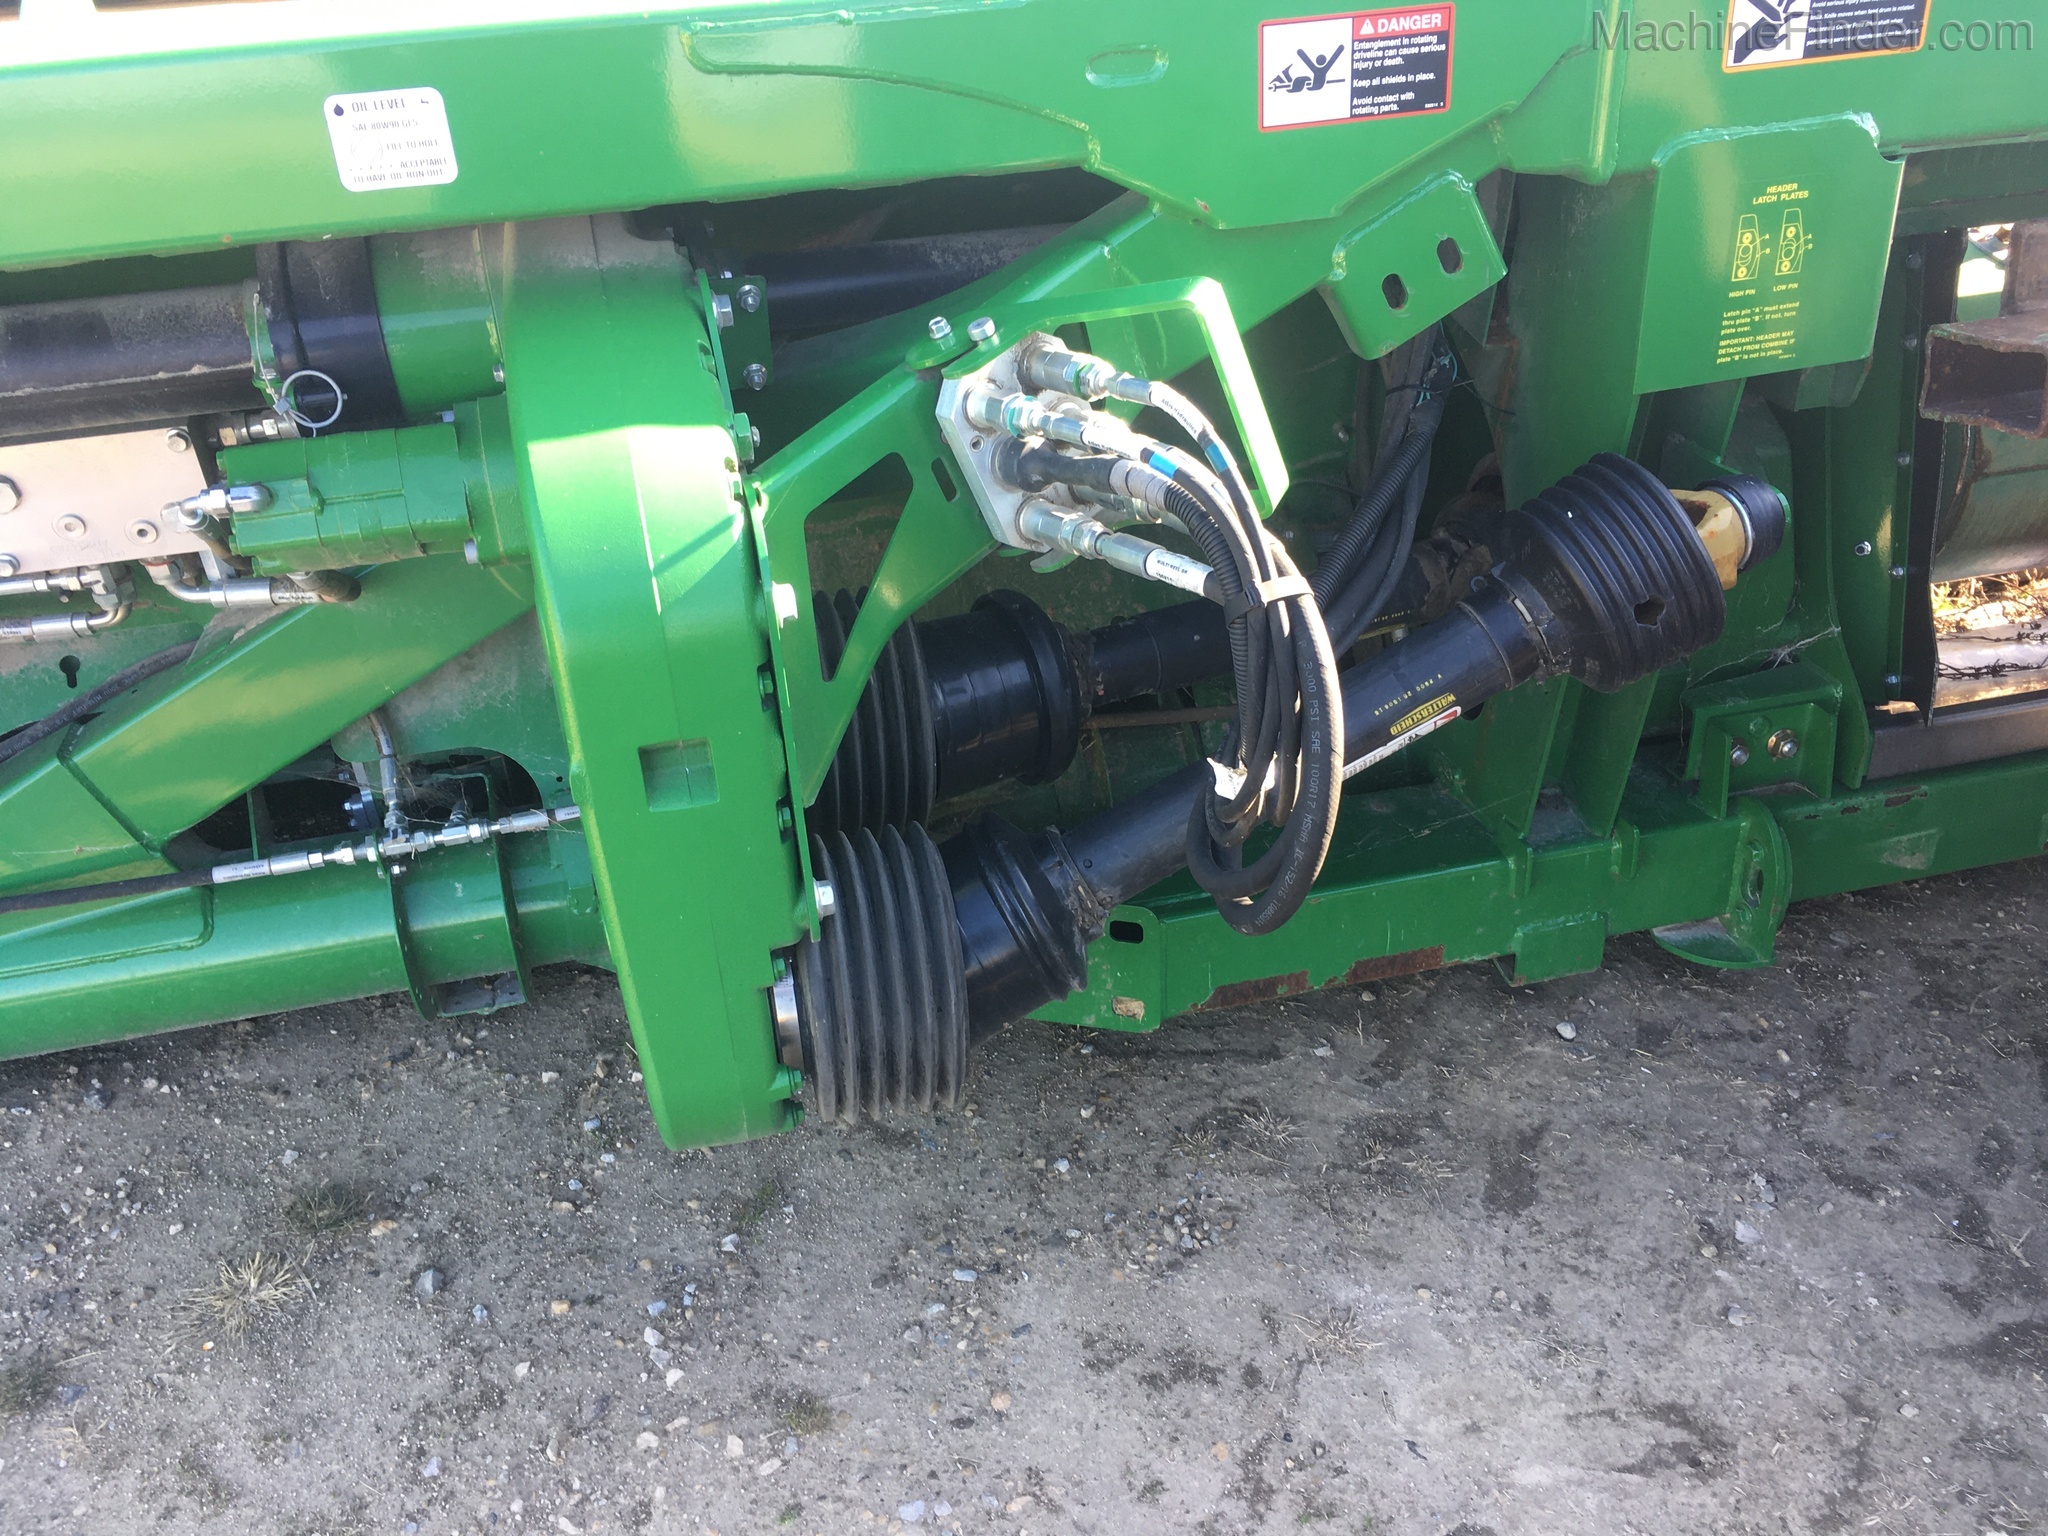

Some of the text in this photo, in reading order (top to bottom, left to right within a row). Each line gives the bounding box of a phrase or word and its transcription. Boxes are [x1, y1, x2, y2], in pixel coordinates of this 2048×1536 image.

[1378, 13, 1442, 33] DANGER
[1353, 35, 1438, 51] Entanglement in rotating
[1353, 43, 1446, 60] driveline can cause serious
[1353, 60, 1374, 71] injury
[1383, 57, 1405, 66] death.
[1353, 72, 1436, 88] Keep all shields in place.
[352, 98, 407, 112] OIL LEVEL
[1352, 91, 1415, 106] Avoid contact with
[1352, 103, 1399, 115] rotating parts.
[400, 157, 447, 169] ACCEPTABLE
[1766, 183, 1798, 194] HEADER
[1752, 190, 1809, 204] LATCH PLATES
[1728, 290, 1744, 298] HIGH
[1763, 304, 1779, 312] must
[1779, 301, 1800, 310] extend
[1735, 317, 1751, 326] plate
[1719, 330, 1794, 347] IMPORTANT: HEADER MAY
[1720, 328, 1736, 336] plate
[1718, 346, 1742, 355] DETACH
[1743, 343, 1760, 352] FROM
[1761, 340, 1789, 349] COMBINE
[1716, 356, 1731, 364] plate
[1767, 349, 1784, 357] place.
[1309, 699, 1320, 721] PSI
[1390, 693, 1457, 736] WALTERSCHEID
[1311, 730, 1321, 754] SAE
[1307, 762, 1320, 809] 100R17
[1298, 813, 1313, 843] MSHA
